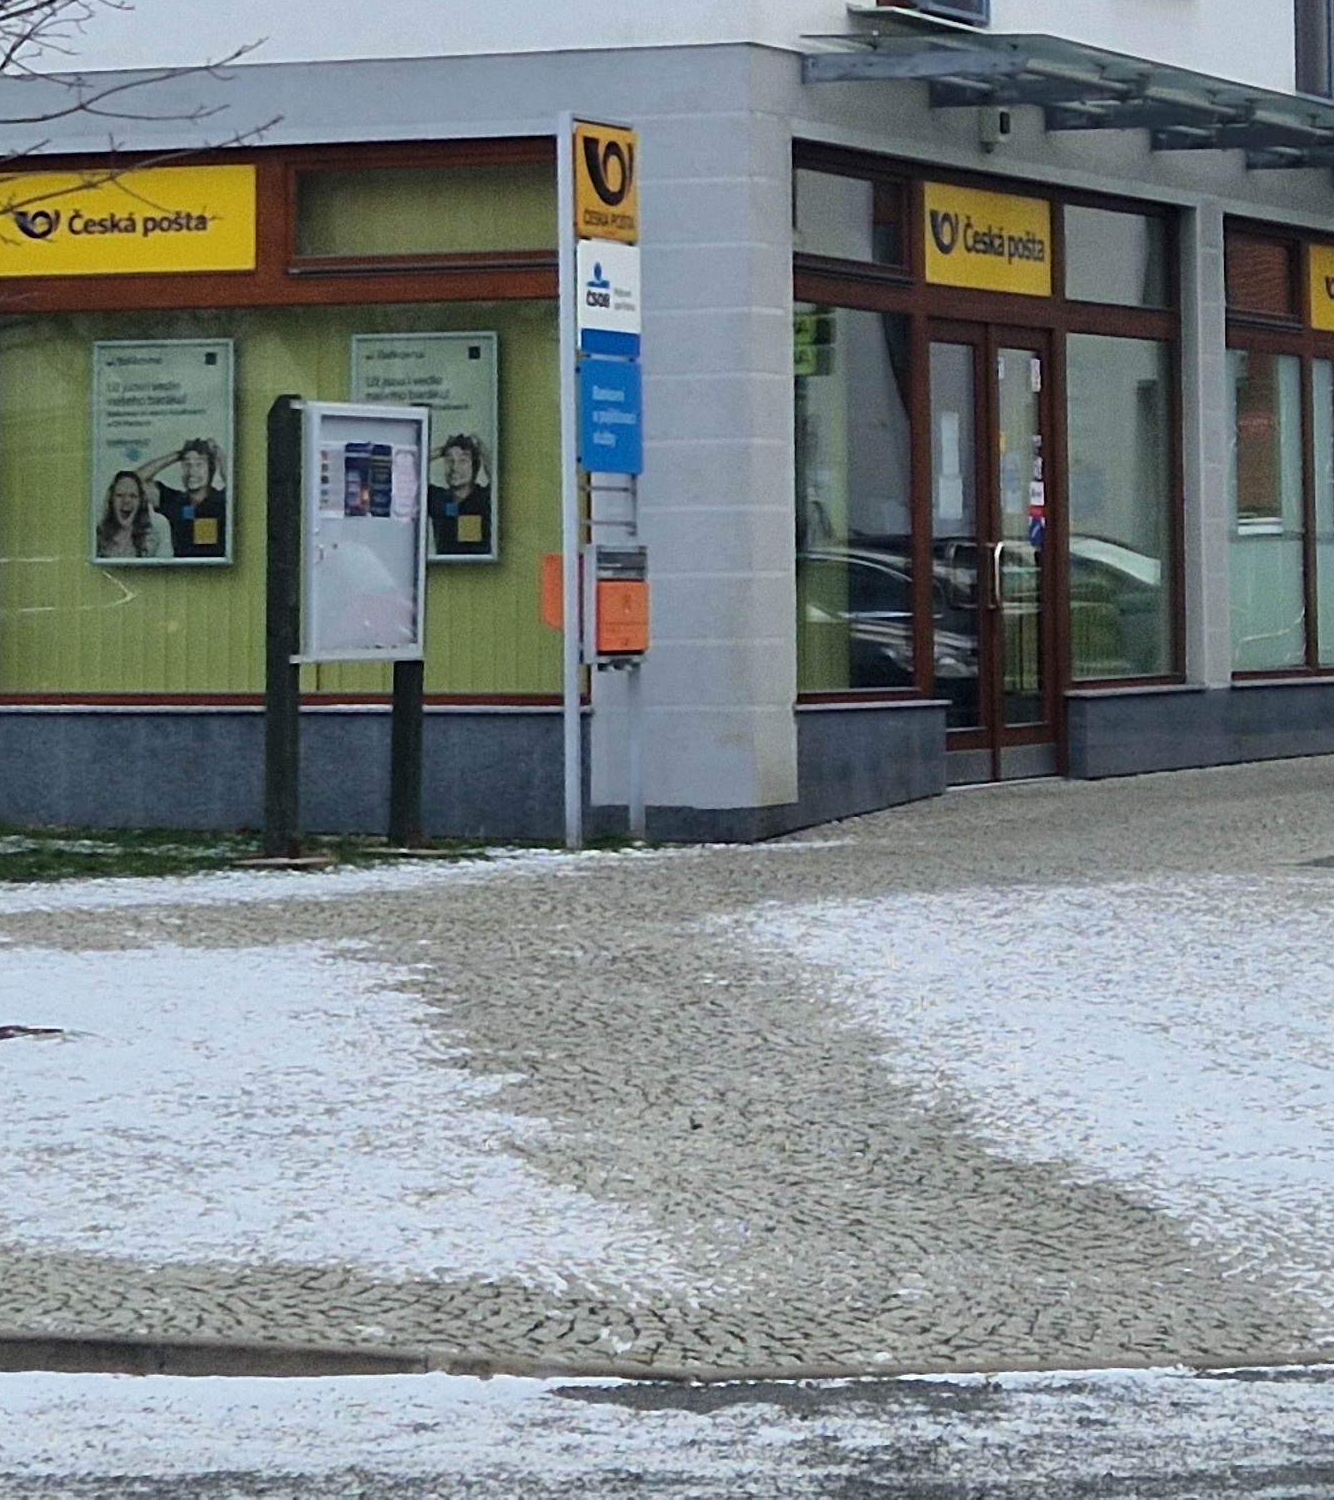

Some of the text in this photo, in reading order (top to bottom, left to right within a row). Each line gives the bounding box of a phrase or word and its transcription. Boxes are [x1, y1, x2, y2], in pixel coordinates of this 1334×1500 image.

[68, 209, 208, 237] Česká pošta
[964, 215, 1045, 264] Česká pošta
